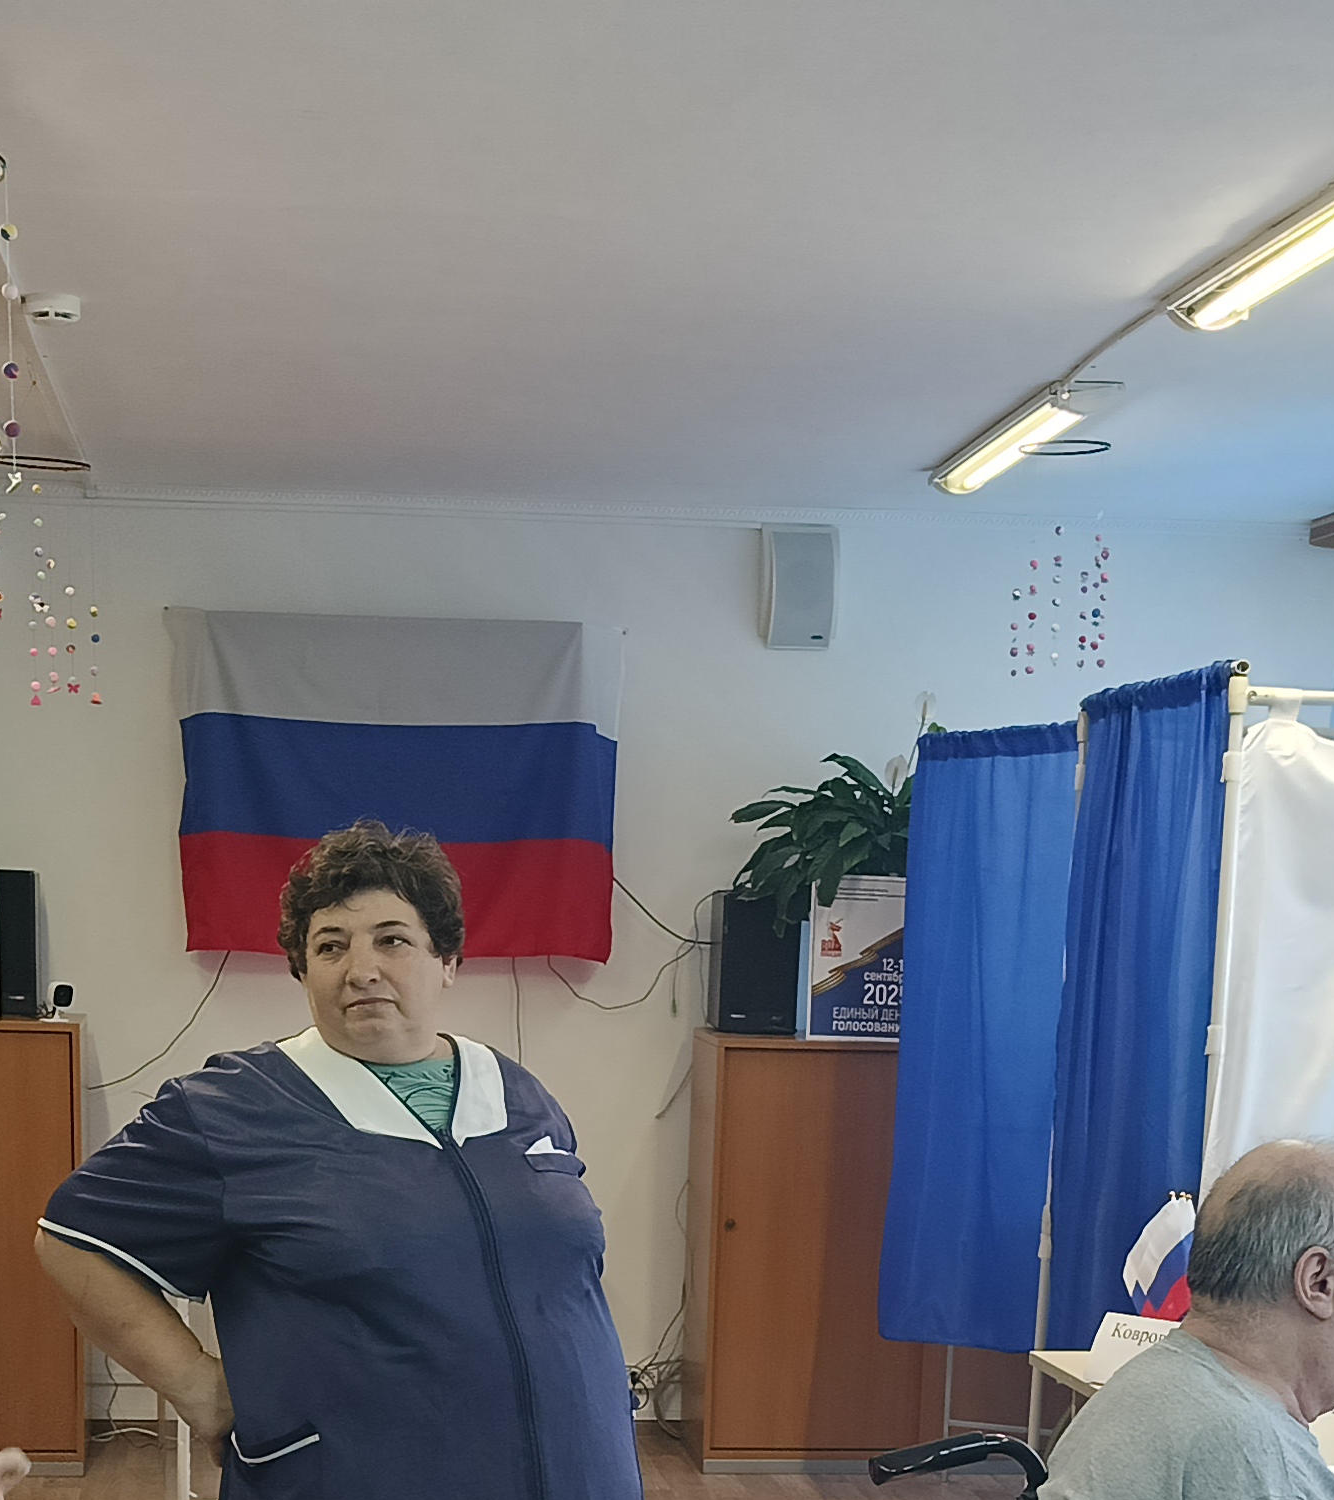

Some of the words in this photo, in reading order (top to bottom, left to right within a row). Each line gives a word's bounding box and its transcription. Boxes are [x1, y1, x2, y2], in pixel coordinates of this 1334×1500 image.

[882, 958, 904, 972] 12-1
[863, 971, 903, 985] сентябр
[832, 1005, 879, 1020] ЕДИНЫЙ
